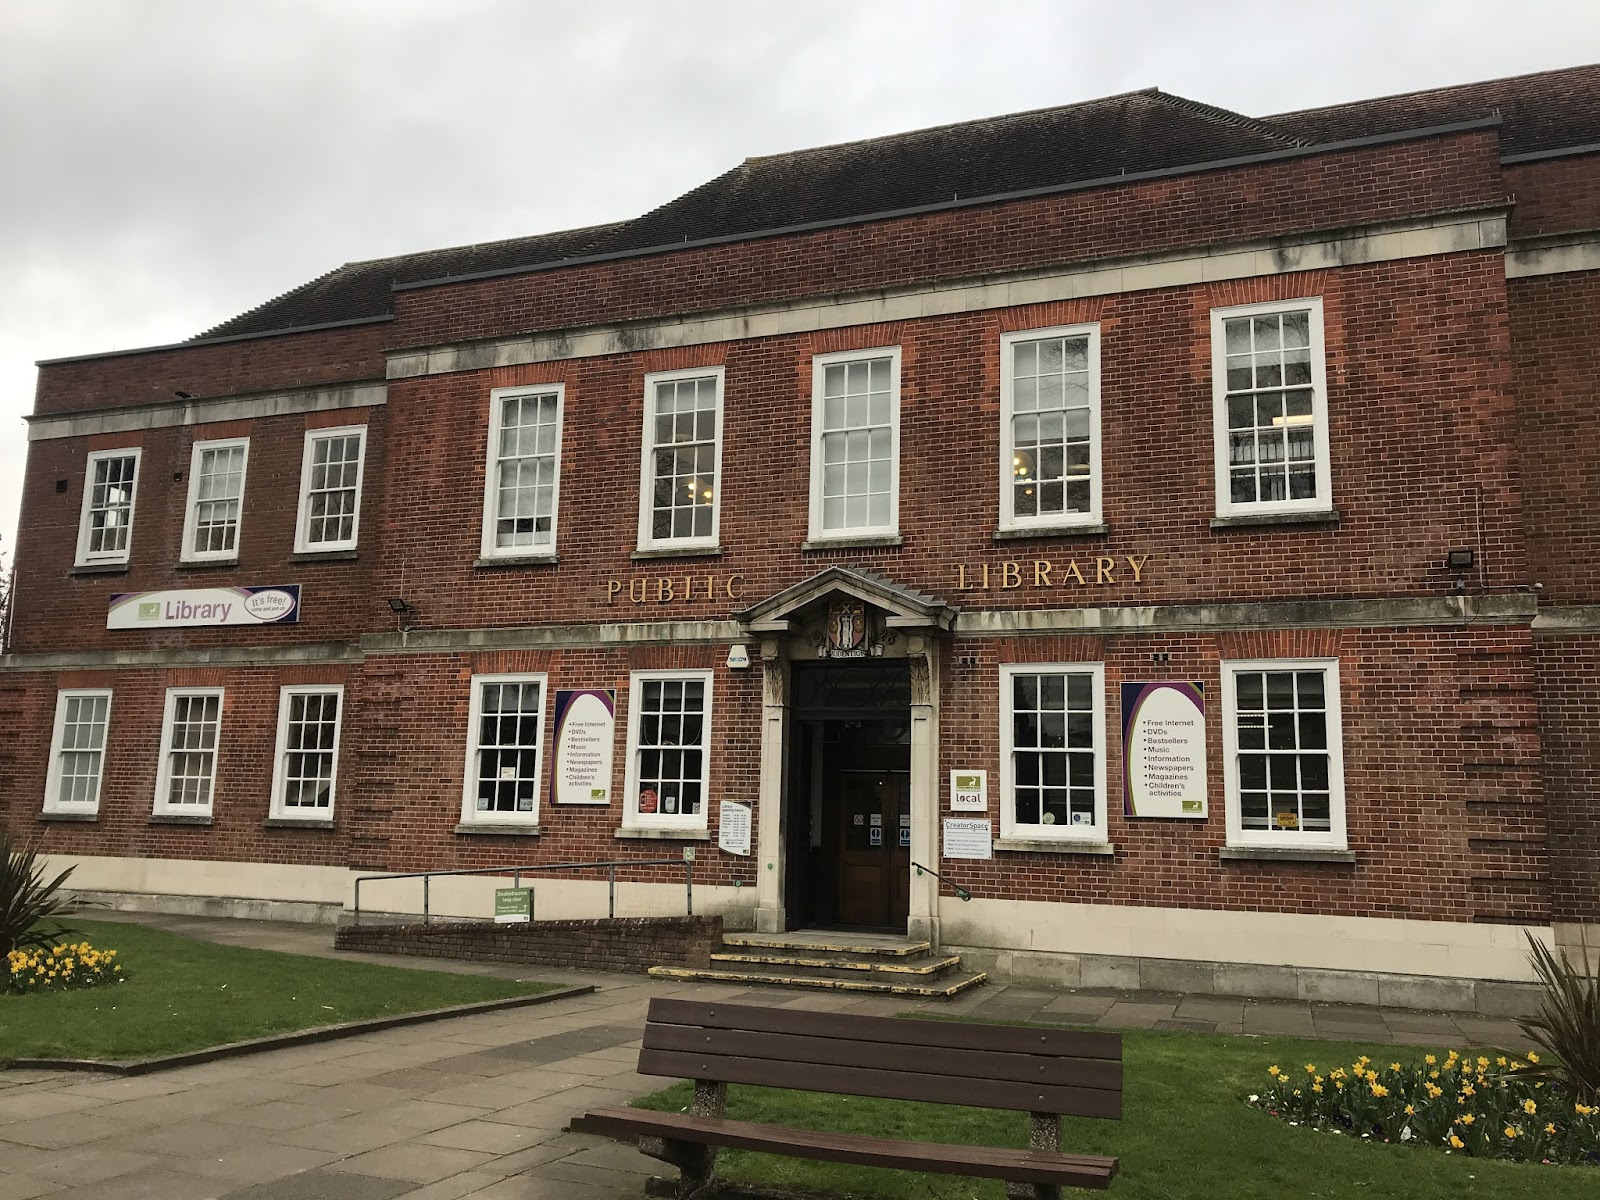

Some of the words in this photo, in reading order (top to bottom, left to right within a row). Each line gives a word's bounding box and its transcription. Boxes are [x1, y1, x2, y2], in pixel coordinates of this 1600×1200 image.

[607, 574, 744, 604] PUBLIC
[958, 555, 1149, 590] LIBRARY
[252, 596, 264, 607] It's
[266, 595, 286, 606] free!
[165, 600, 232, 622] Library
[956, 793, 981, 803] local
